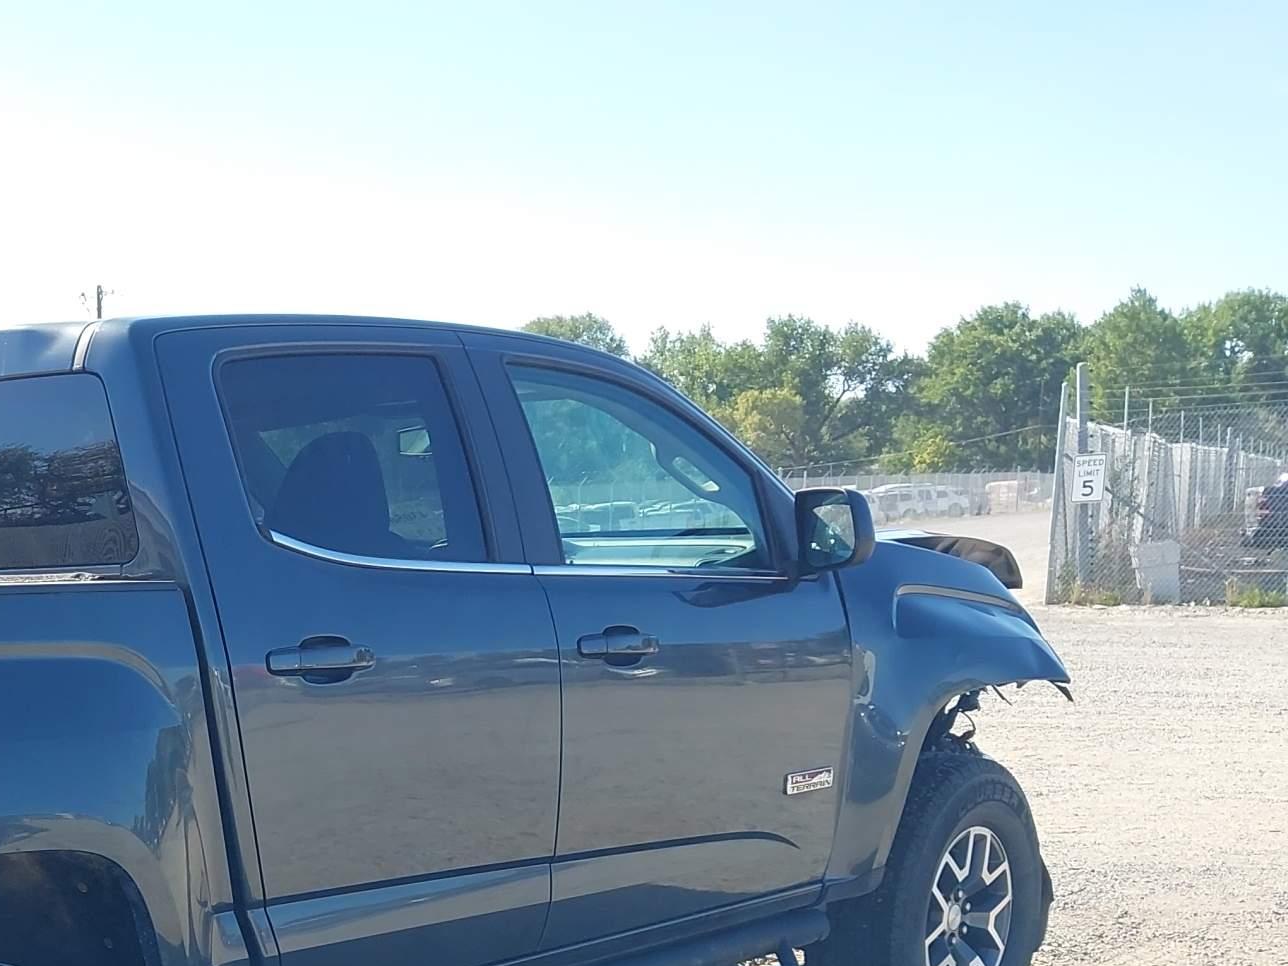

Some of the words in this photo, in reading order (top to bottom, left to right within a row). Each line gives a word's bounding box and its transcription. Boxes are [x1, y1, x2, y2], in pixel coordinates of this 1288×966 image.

[1076, 458, 1104, 467] SPEED
[1078, 469, 1100, 477] LIMIT
[1081, 479, 1094, 497] 5
[793, 773, 812, 784] ALL
[791, 779, 831, 793] TERRAIN
